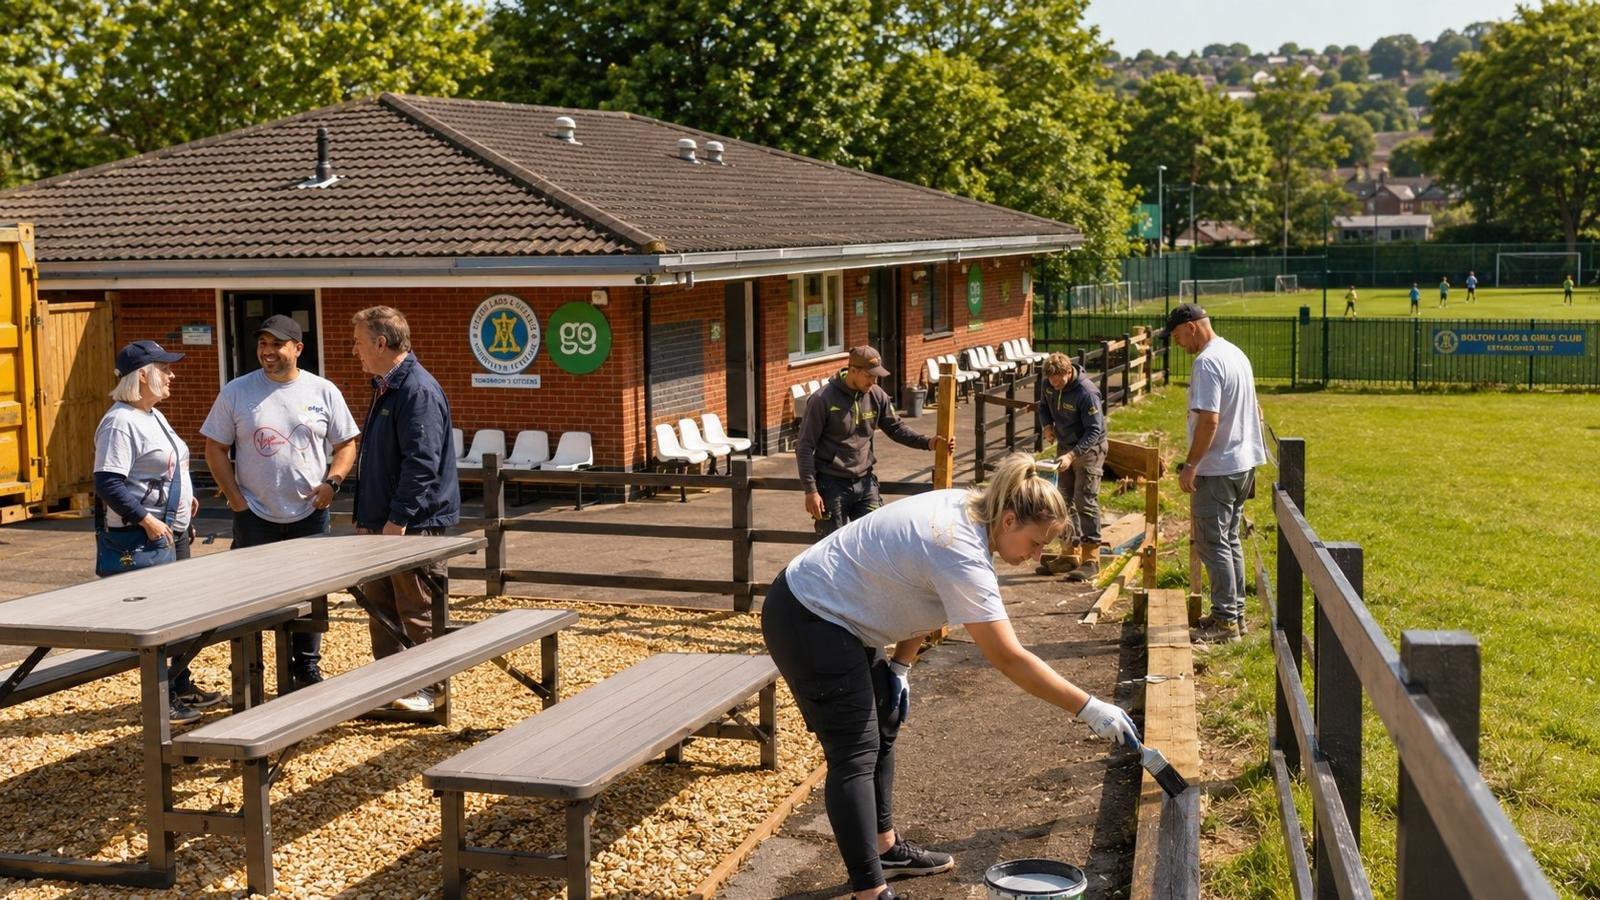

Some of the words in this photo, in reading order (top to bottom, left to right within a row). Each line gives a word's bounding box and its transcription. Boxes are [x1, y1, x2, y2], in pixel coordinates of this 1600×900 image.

[1461, 334, 1496, 342] BOLTON
[1498, 334, 1520, 342] LADS
[1530, 334, 1557, 342] GIRLS
[1558, 334, 1582, 342] CLUB
